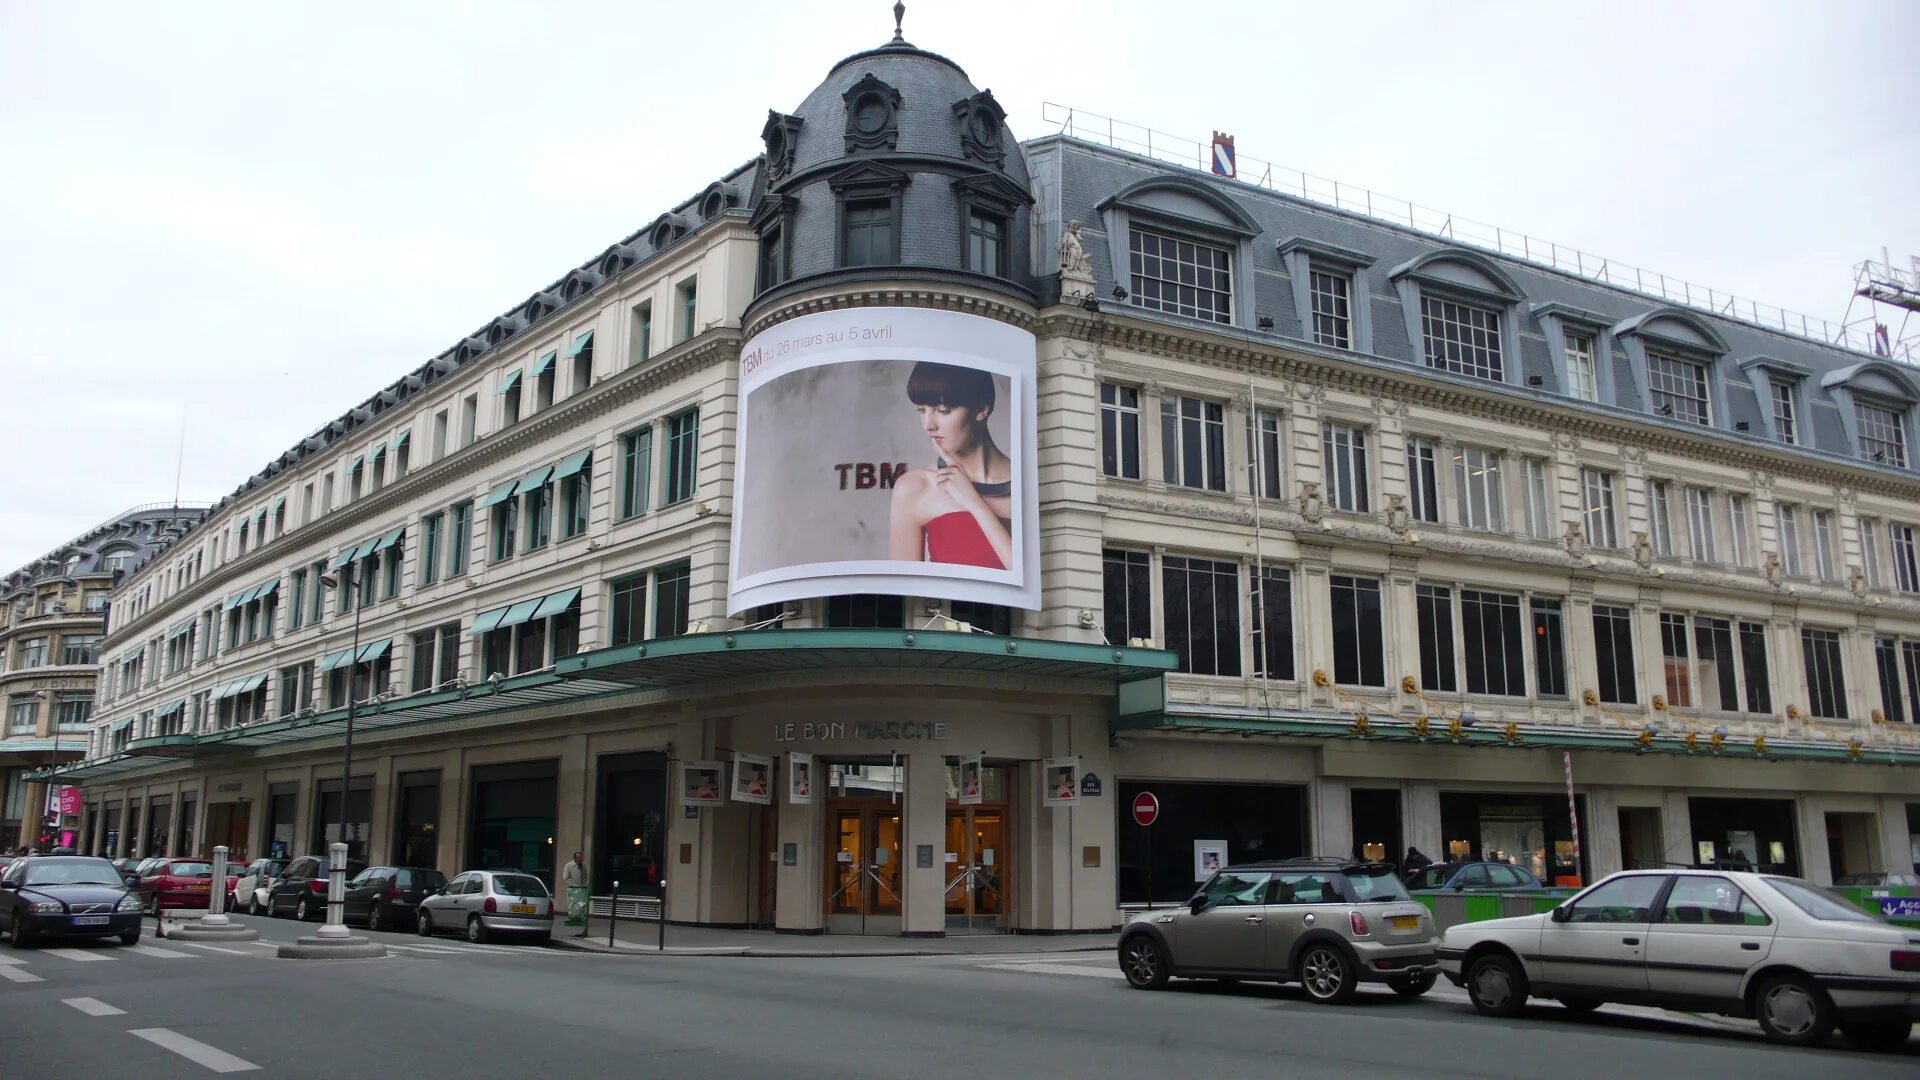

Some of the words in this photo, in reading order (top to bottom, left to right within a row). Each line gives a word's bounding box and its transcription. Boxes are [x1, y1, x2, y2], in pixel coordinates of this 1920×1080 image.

[742, 347, 763, 376] TBM
[763, 350, 775, 363] du
[776, 340, 790, 356] 26
[792, 335, 823, 350] mars
[826, 332, 843, 343] au
[849, 326, 858, 340] 5
[862, 325, 892, 340] avril
[834, 462, 908, 490] TBM
[51, 679, 79, 688] BON
[775, 723, 796, 741] LE
[804, 722, 845, 740] BON
